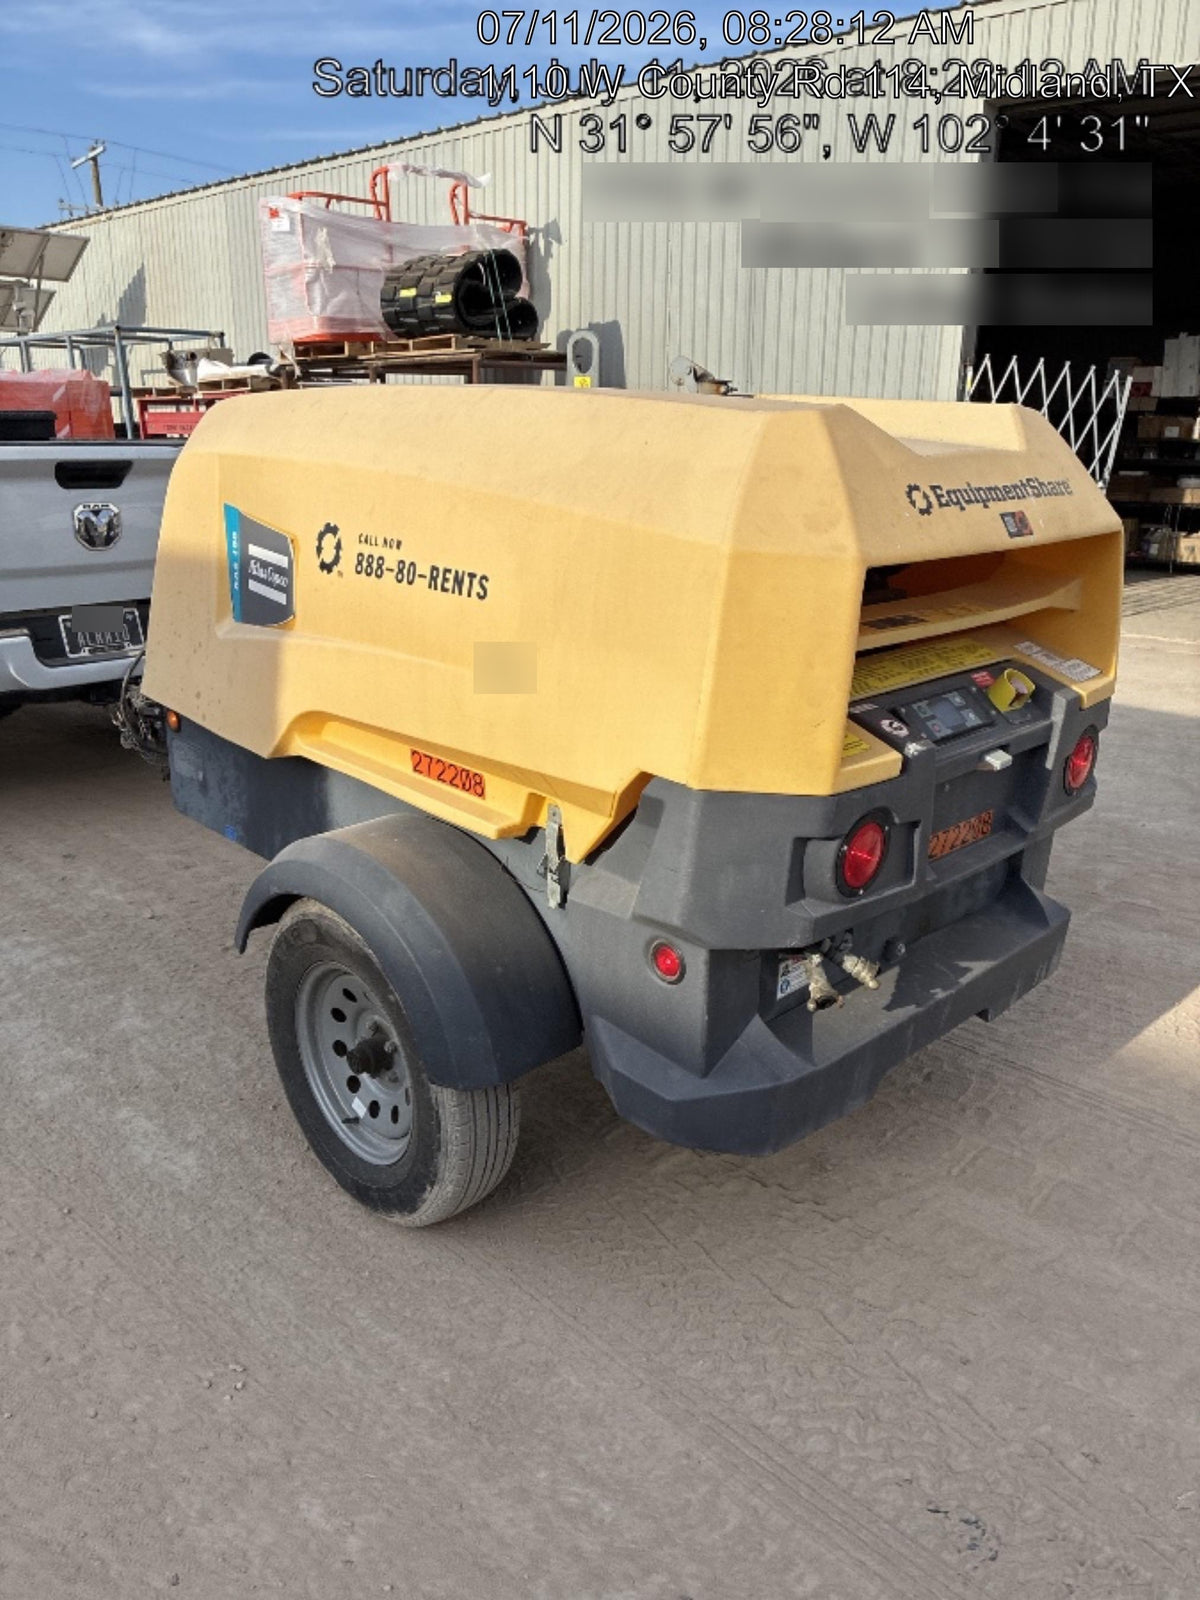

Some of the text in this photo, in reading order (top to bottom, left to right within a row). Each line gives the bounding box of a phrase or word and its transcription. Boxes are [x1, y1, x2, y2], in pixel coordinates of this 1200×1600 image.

[929, 477, 1073, 511] EquipmentShare
[358, 532, 379, 547] CALL
[354, 552, 489, 601] 888-80-RENTS
[411, 749, 485, 798] 272208
